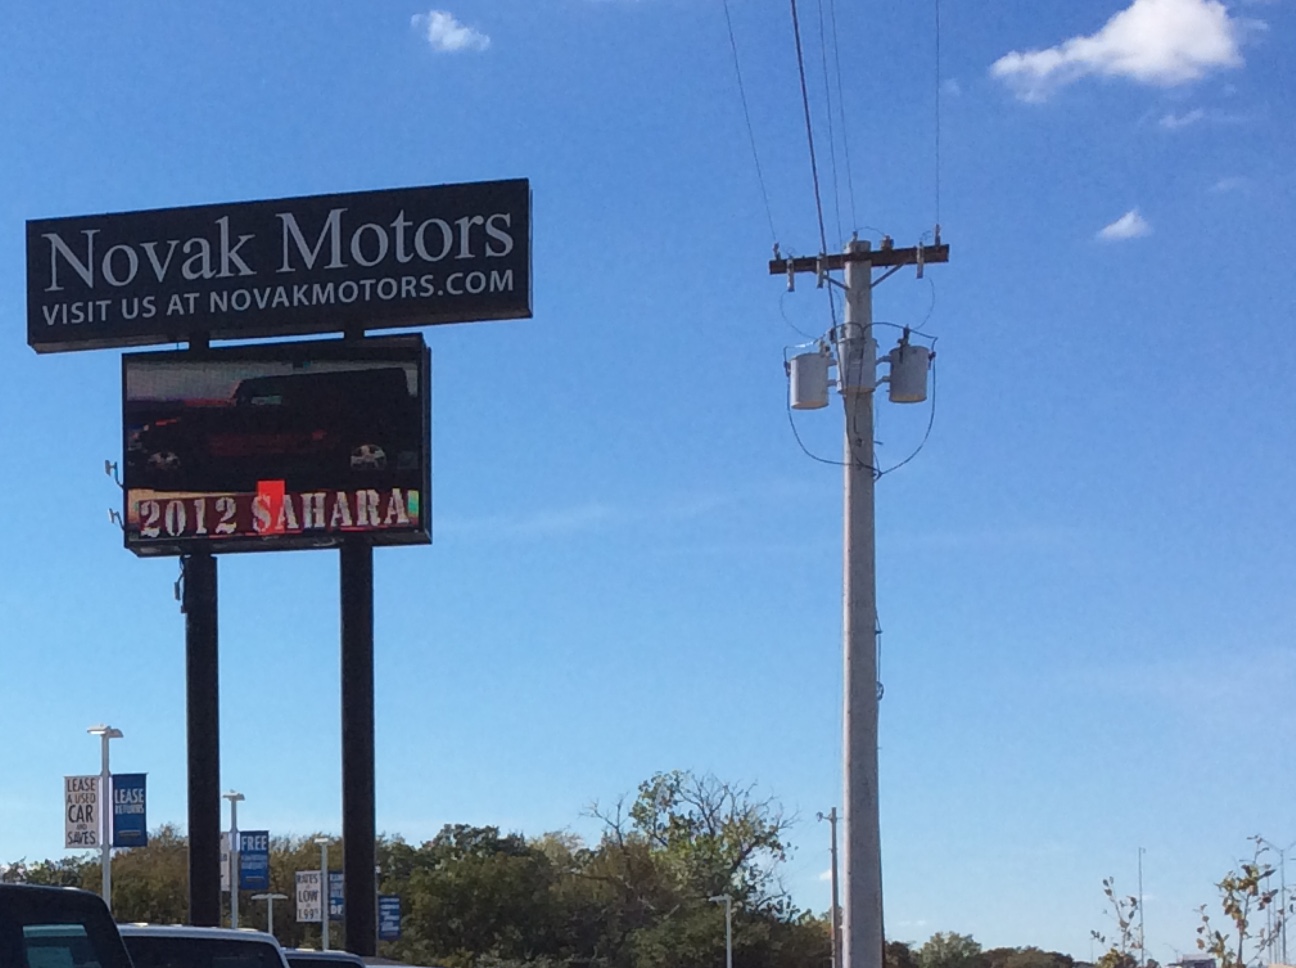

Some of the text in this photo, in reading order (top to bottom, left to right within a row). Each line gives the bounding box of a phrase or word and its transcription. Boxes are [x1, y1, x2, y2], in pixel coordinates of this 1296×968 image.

[41, 208, 515, 292] Novak Motors
[42, 268, 515, 326] VISIT US AT NOVAKMOTORS.COM
[139, 488, 410, 539] 2012 SAHARA
[67, 778, 96, 792] LEASE
[114, 788, 144, 804] LEASE
[68, 804, 94, 823] CAR
[241, 835, 267, 851] FREE
